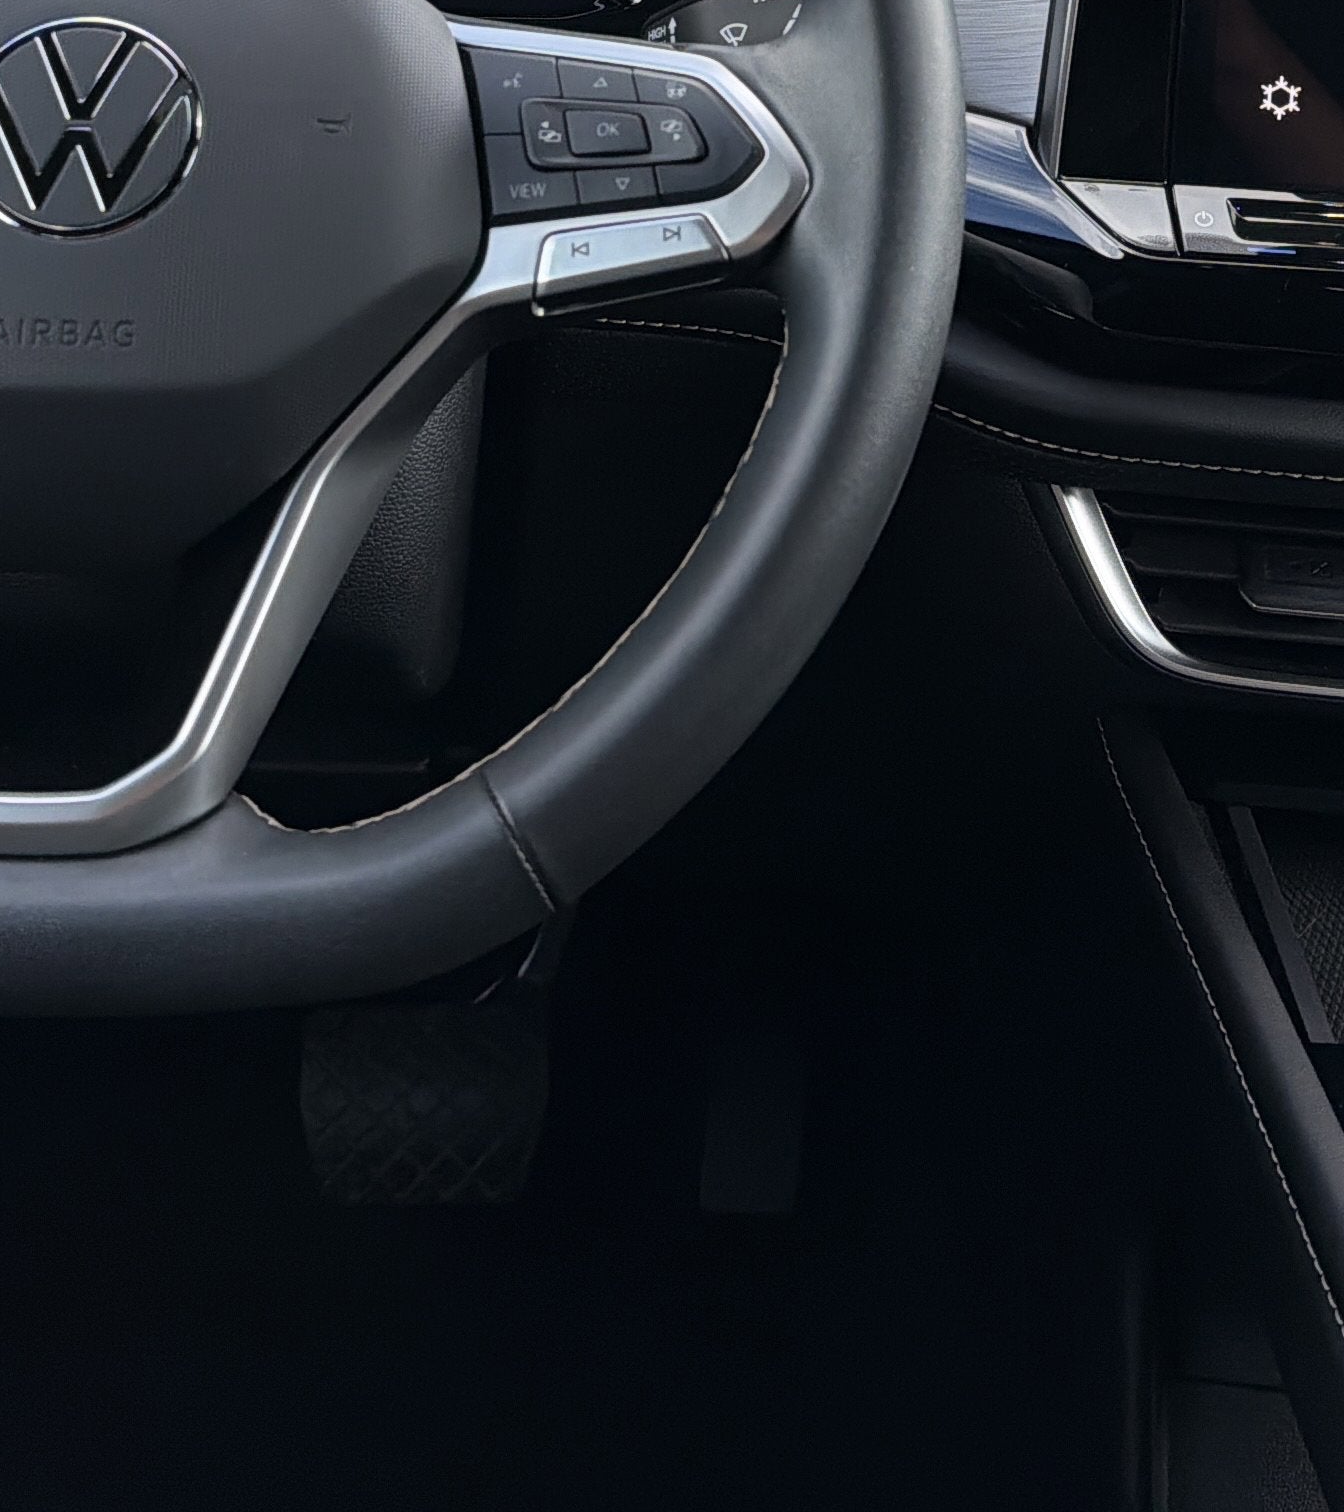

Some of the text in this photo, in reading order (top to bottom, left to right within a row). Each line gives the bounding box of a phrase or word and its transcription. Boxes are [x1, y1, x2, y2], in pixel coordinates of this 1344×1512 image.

[647, 24, 666, 41] HIGH
[597, 122, 619, 136] OK
[510, 183, 546, 198] VIEW
